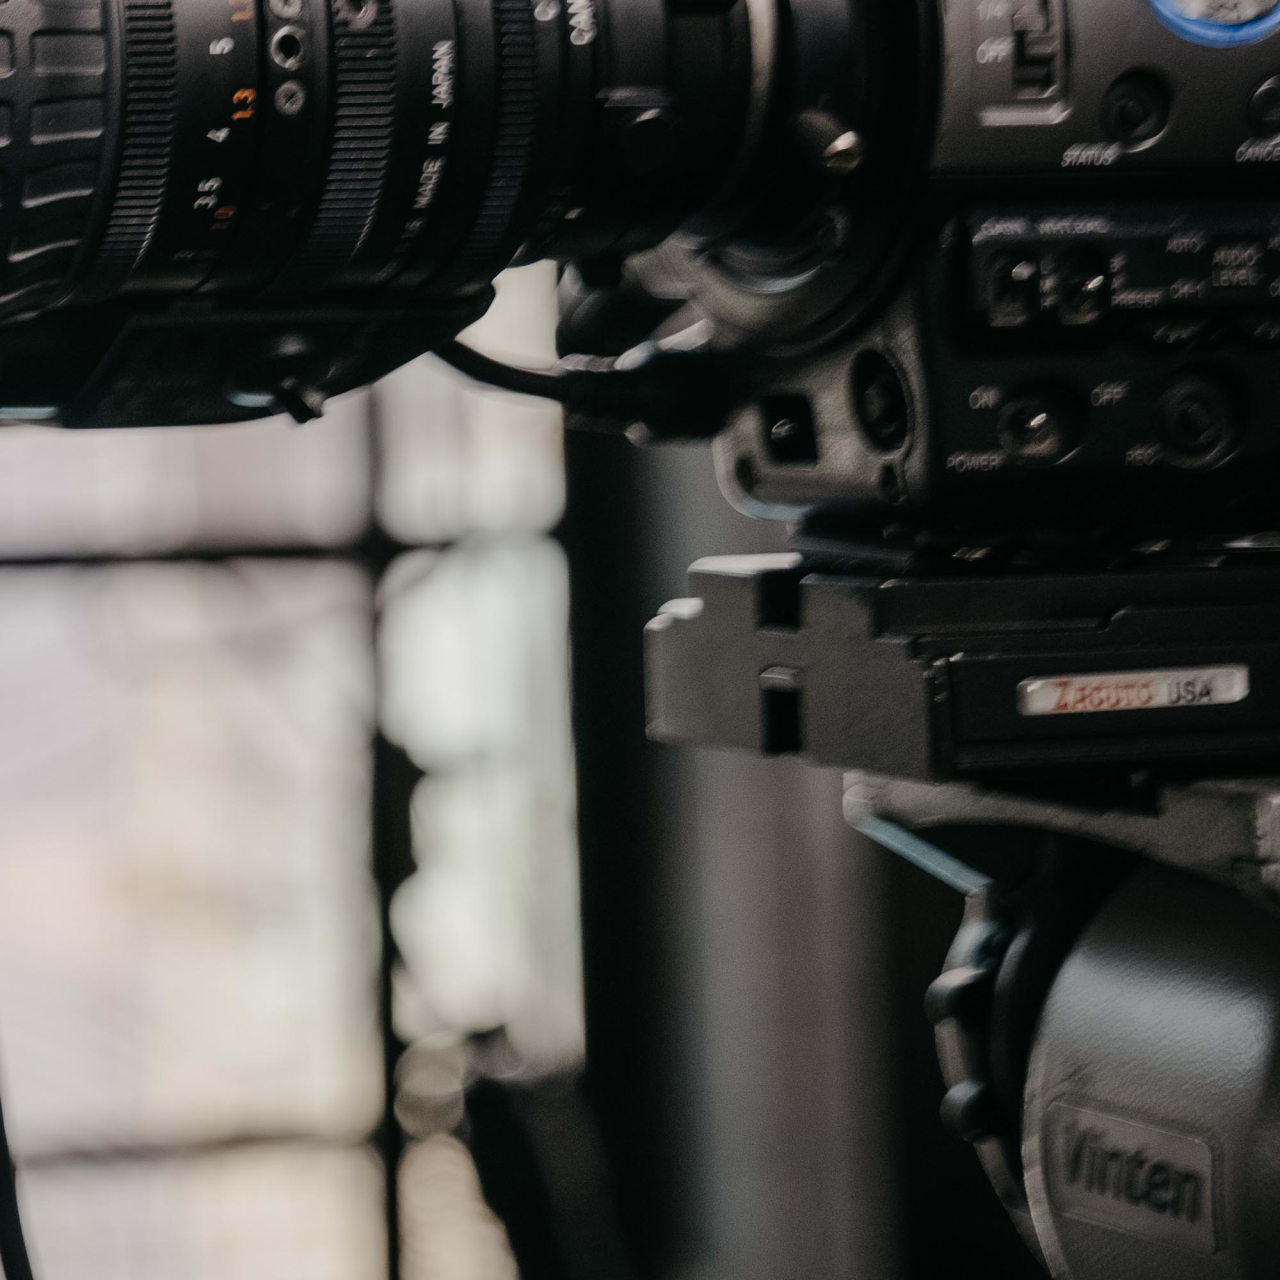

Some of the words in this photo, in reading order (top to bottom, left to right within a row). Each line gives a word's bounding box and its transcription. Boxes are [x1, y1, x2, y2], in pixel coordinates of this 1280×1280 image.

[976, 38, 1014, 64] OFF
[432, 40, 456, 110] JAPAN
[427, 122, 450, 145] IN
[1060, 142, 1122, 167] STATUS
[412, 156, 444, 210] MADE
[1212, 244, 1262, 267] AUDIO
[1212, 267, 1257, 287] LEVEL
[1111, 289, 1166, 310] PRESET
[969, 385, 1000, 410] ON
[1091, 381, 1132, 408] OFF
[946, 451, 1004, 472] POWER
[1166, 678, 1214, 706] USA
[1063, 1124, 1201, 1224] Vinten
